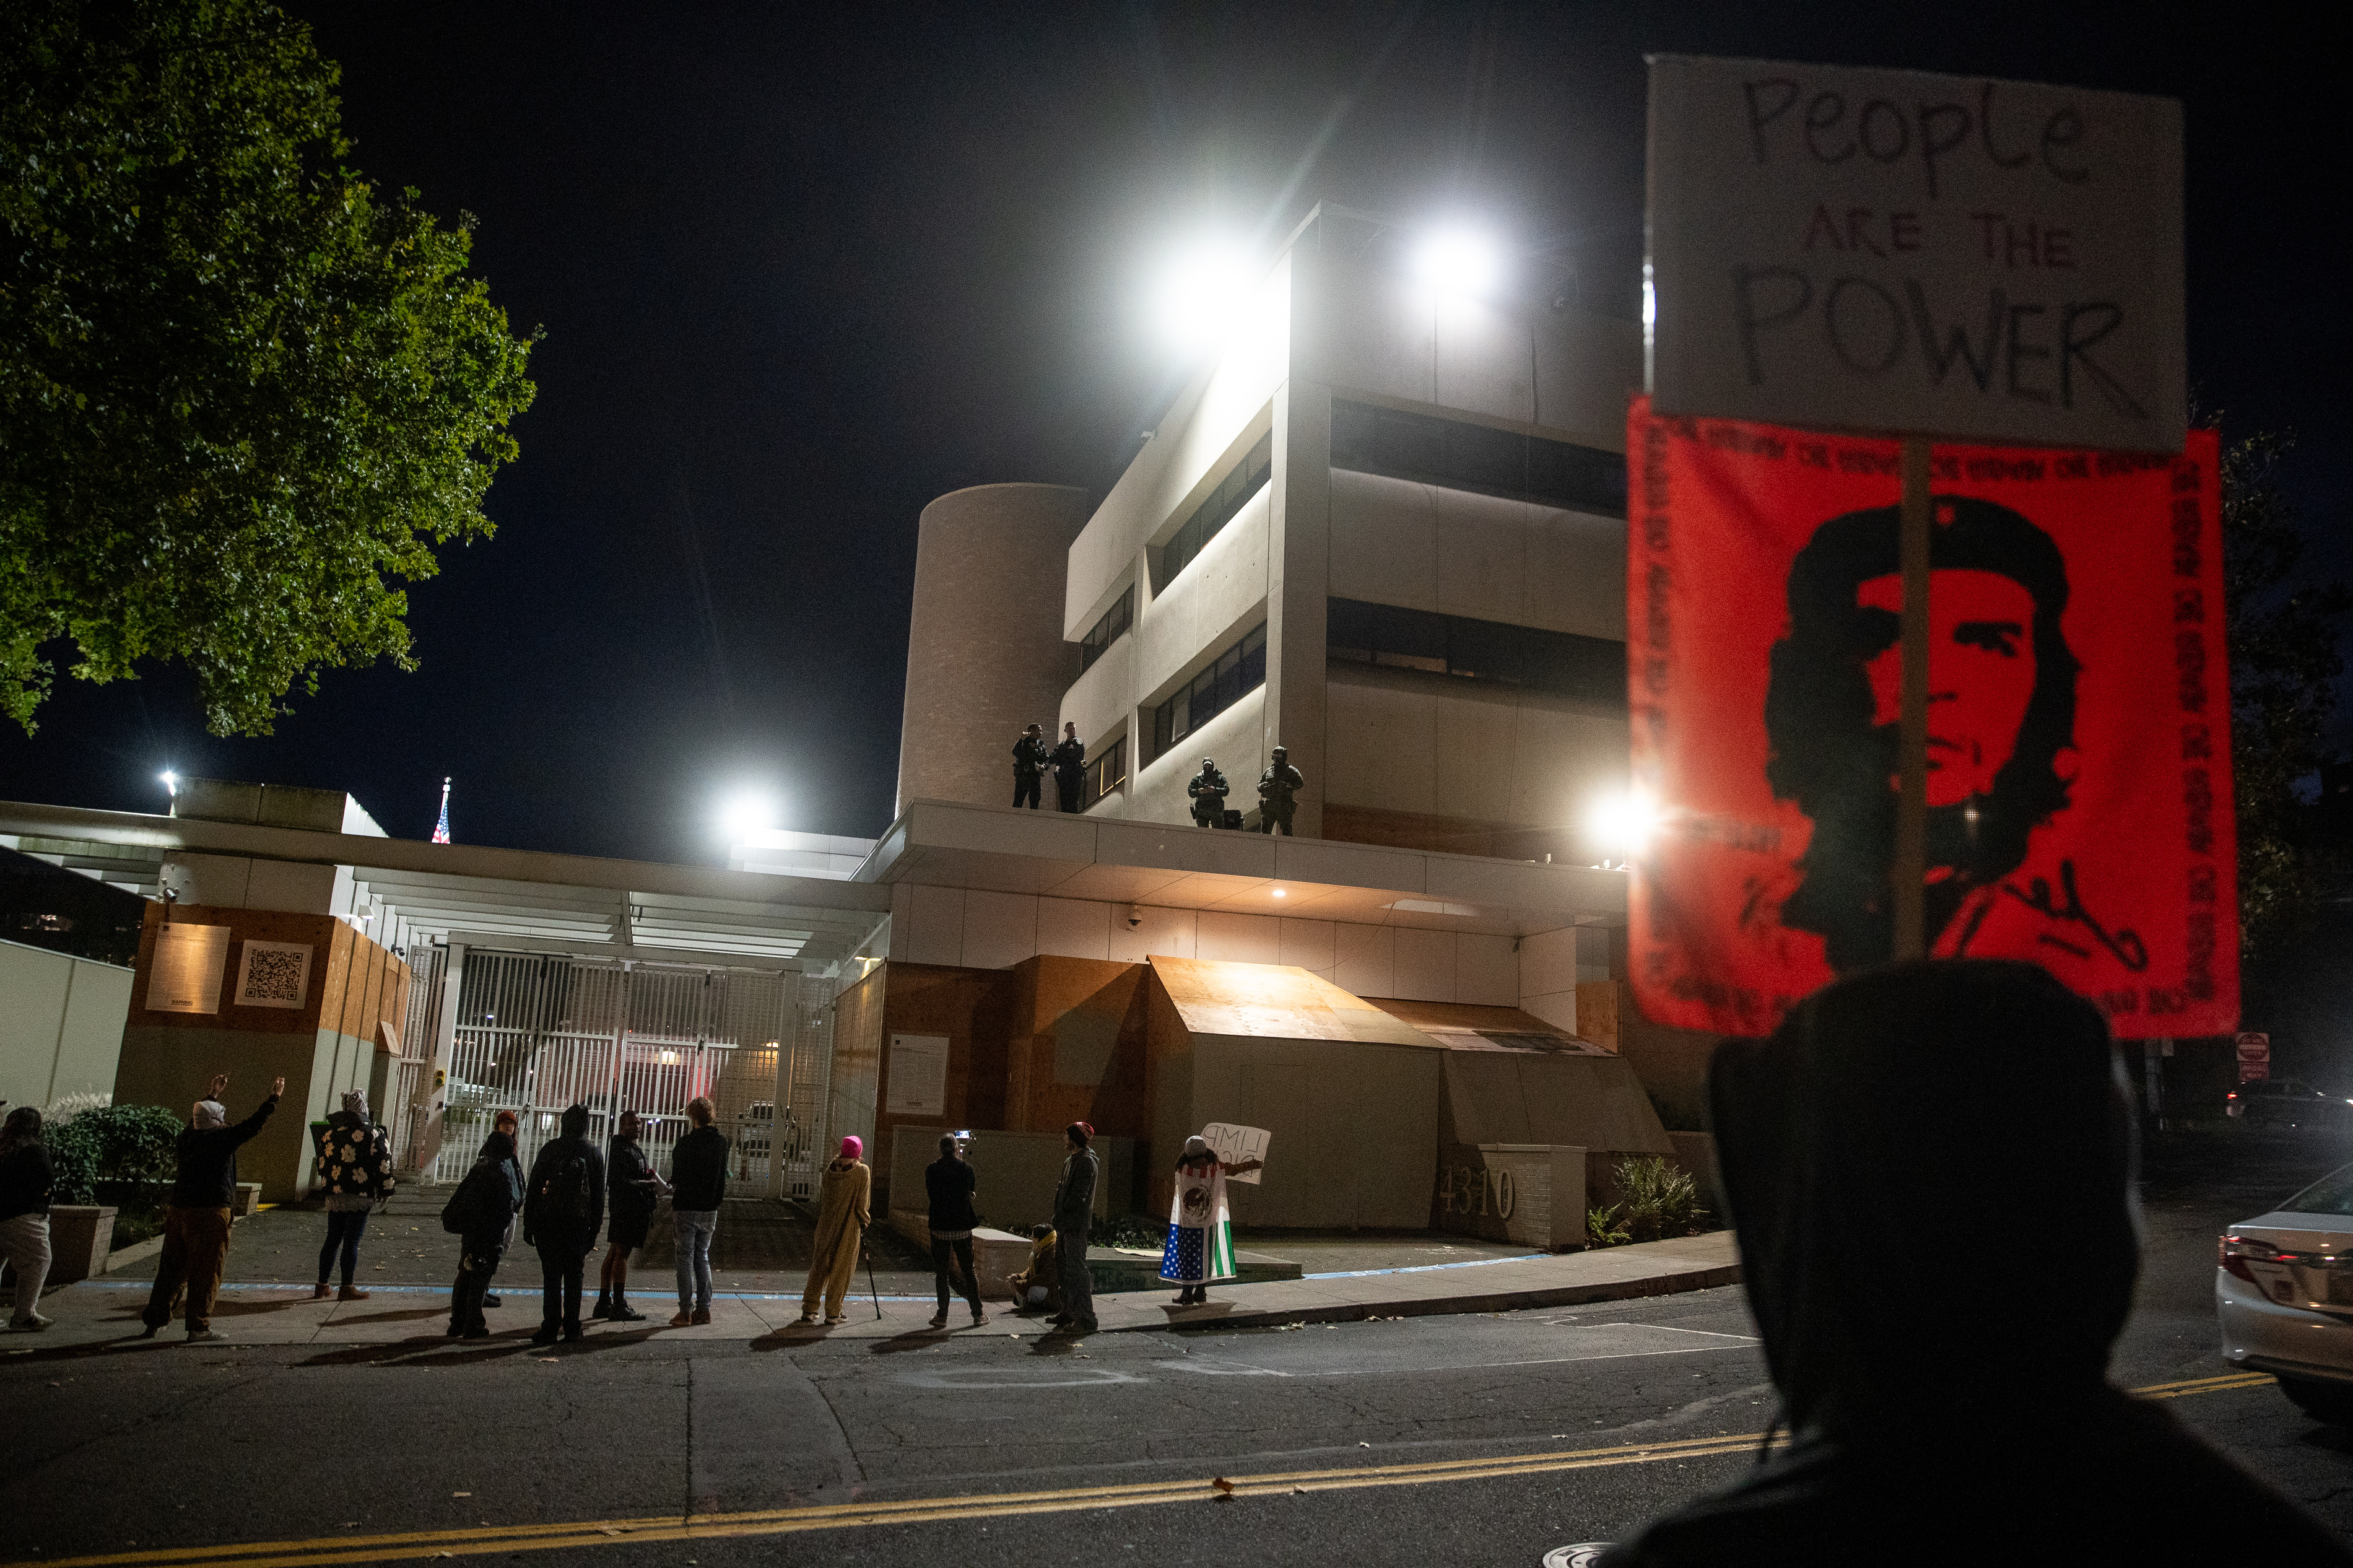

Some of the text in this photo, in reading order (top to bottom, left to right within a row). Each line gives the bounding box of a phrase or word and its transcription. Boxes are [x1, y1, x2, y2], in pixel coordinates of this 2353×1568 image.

[1802, 202, 2079, 269] ARE THE
[1737, 265, 2150, 419] POWER
[1439, 1165, 1513, 1219] 4310
